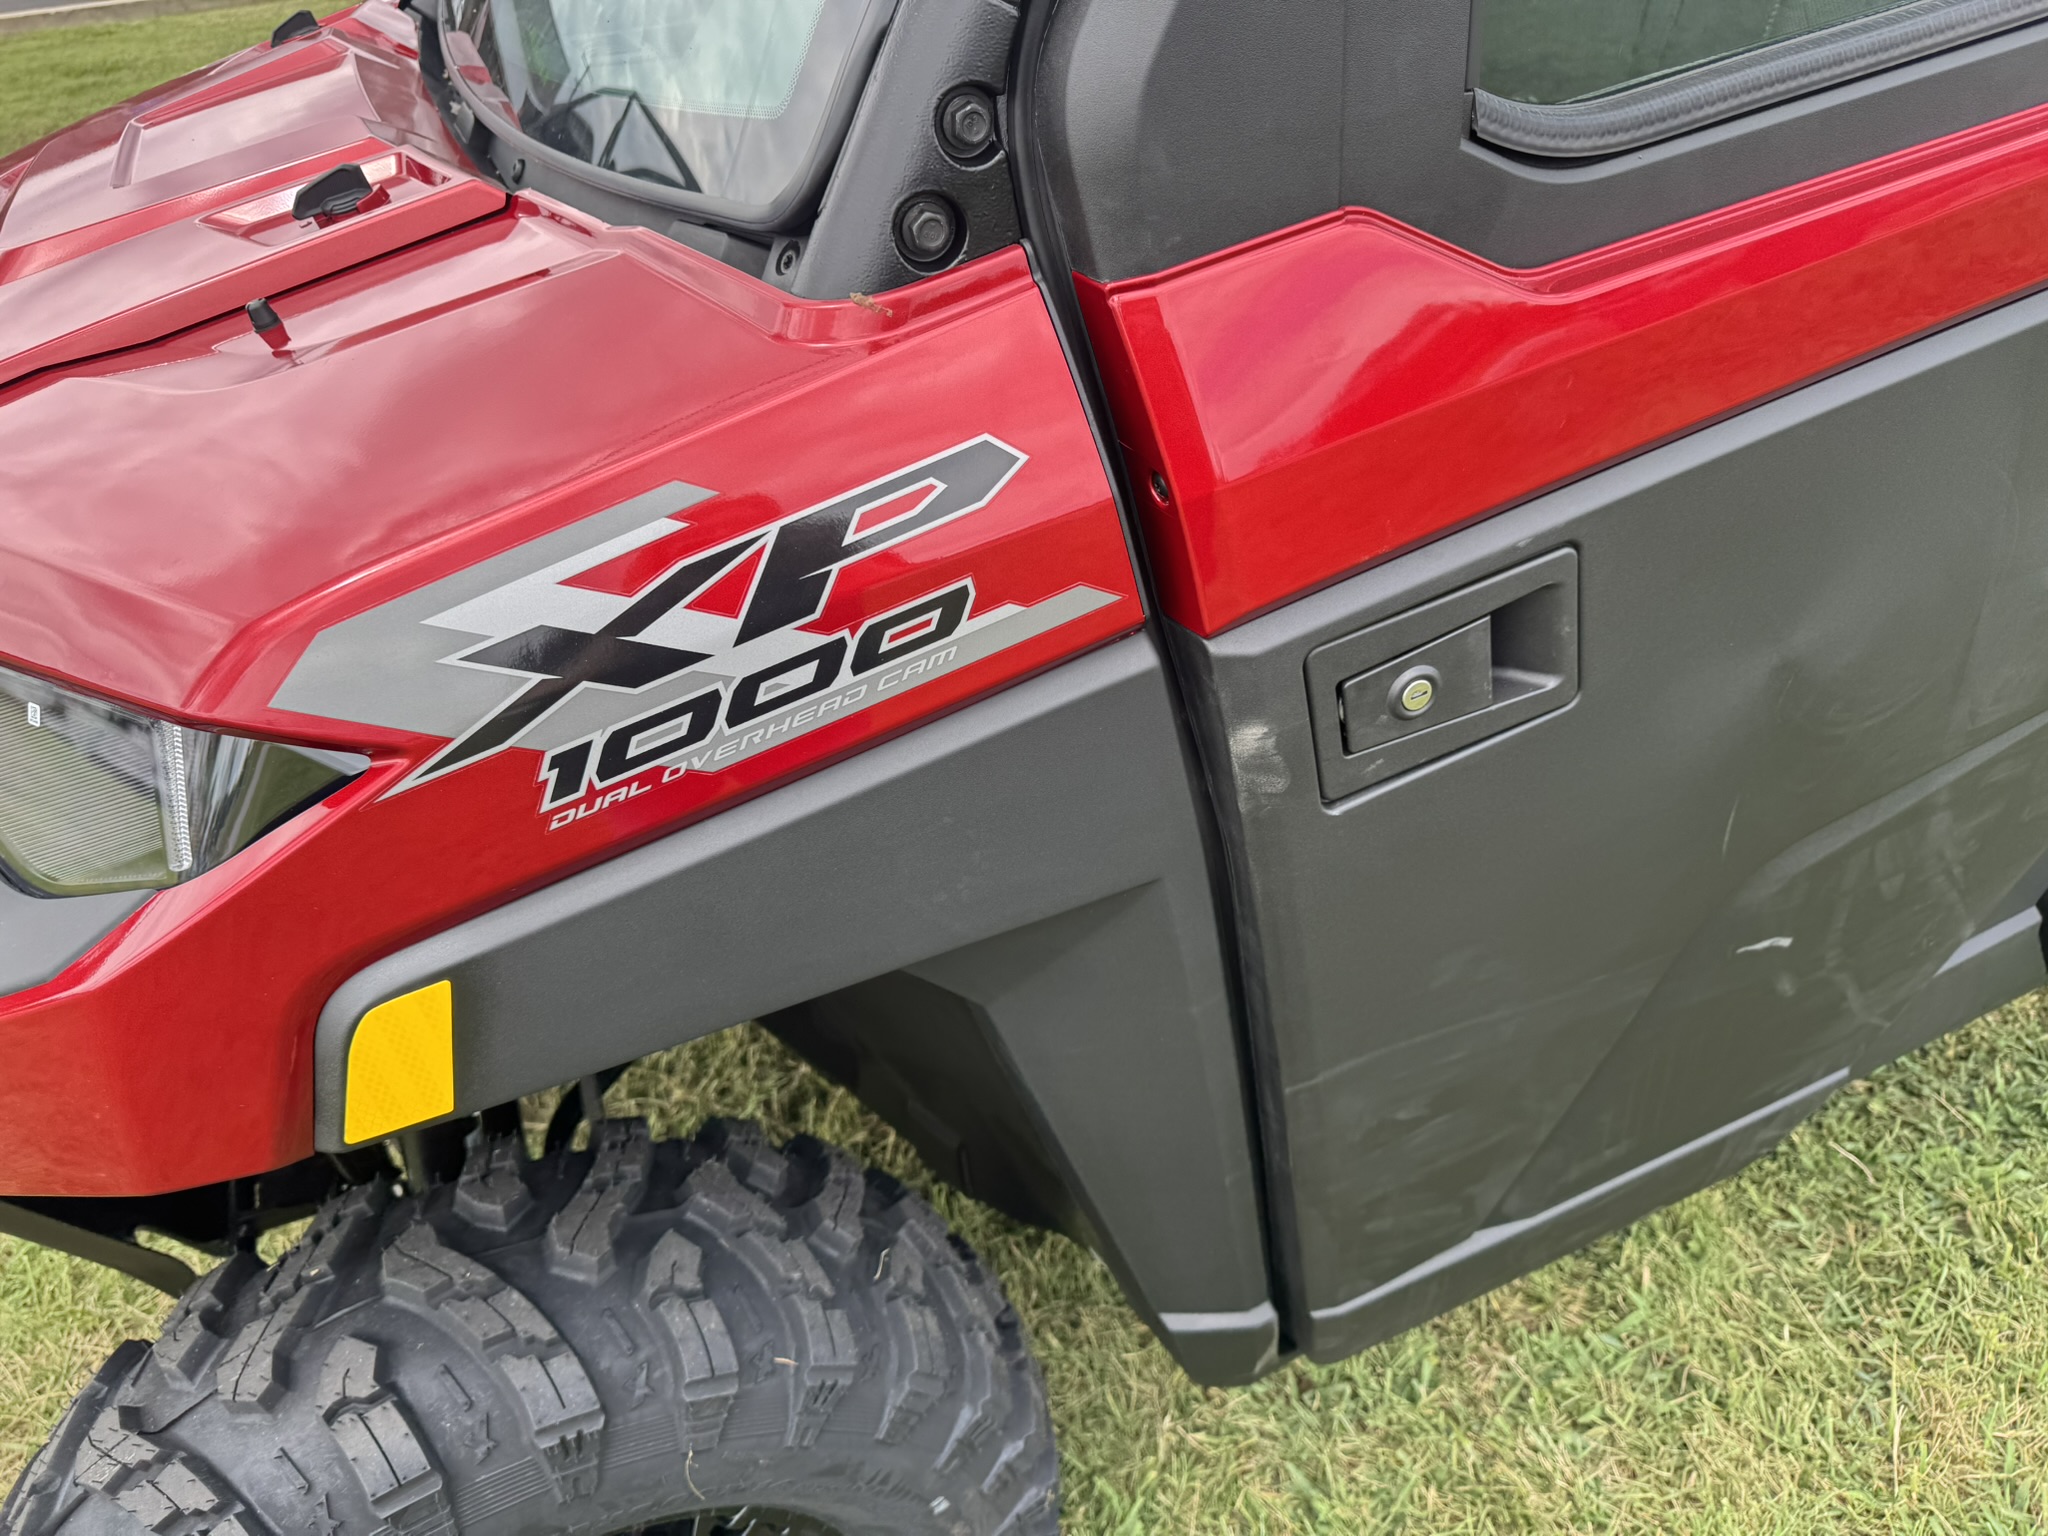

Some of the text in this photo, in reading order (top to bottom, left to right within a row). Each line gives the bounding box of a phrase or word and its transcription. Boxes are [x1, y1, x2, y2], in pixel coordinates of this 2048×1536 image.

[383, 435, 1027, 796] XP
[541, 579, 974, 810] 1000
[549, 646, 958, 831] DUAL OVERHEAD CAM
